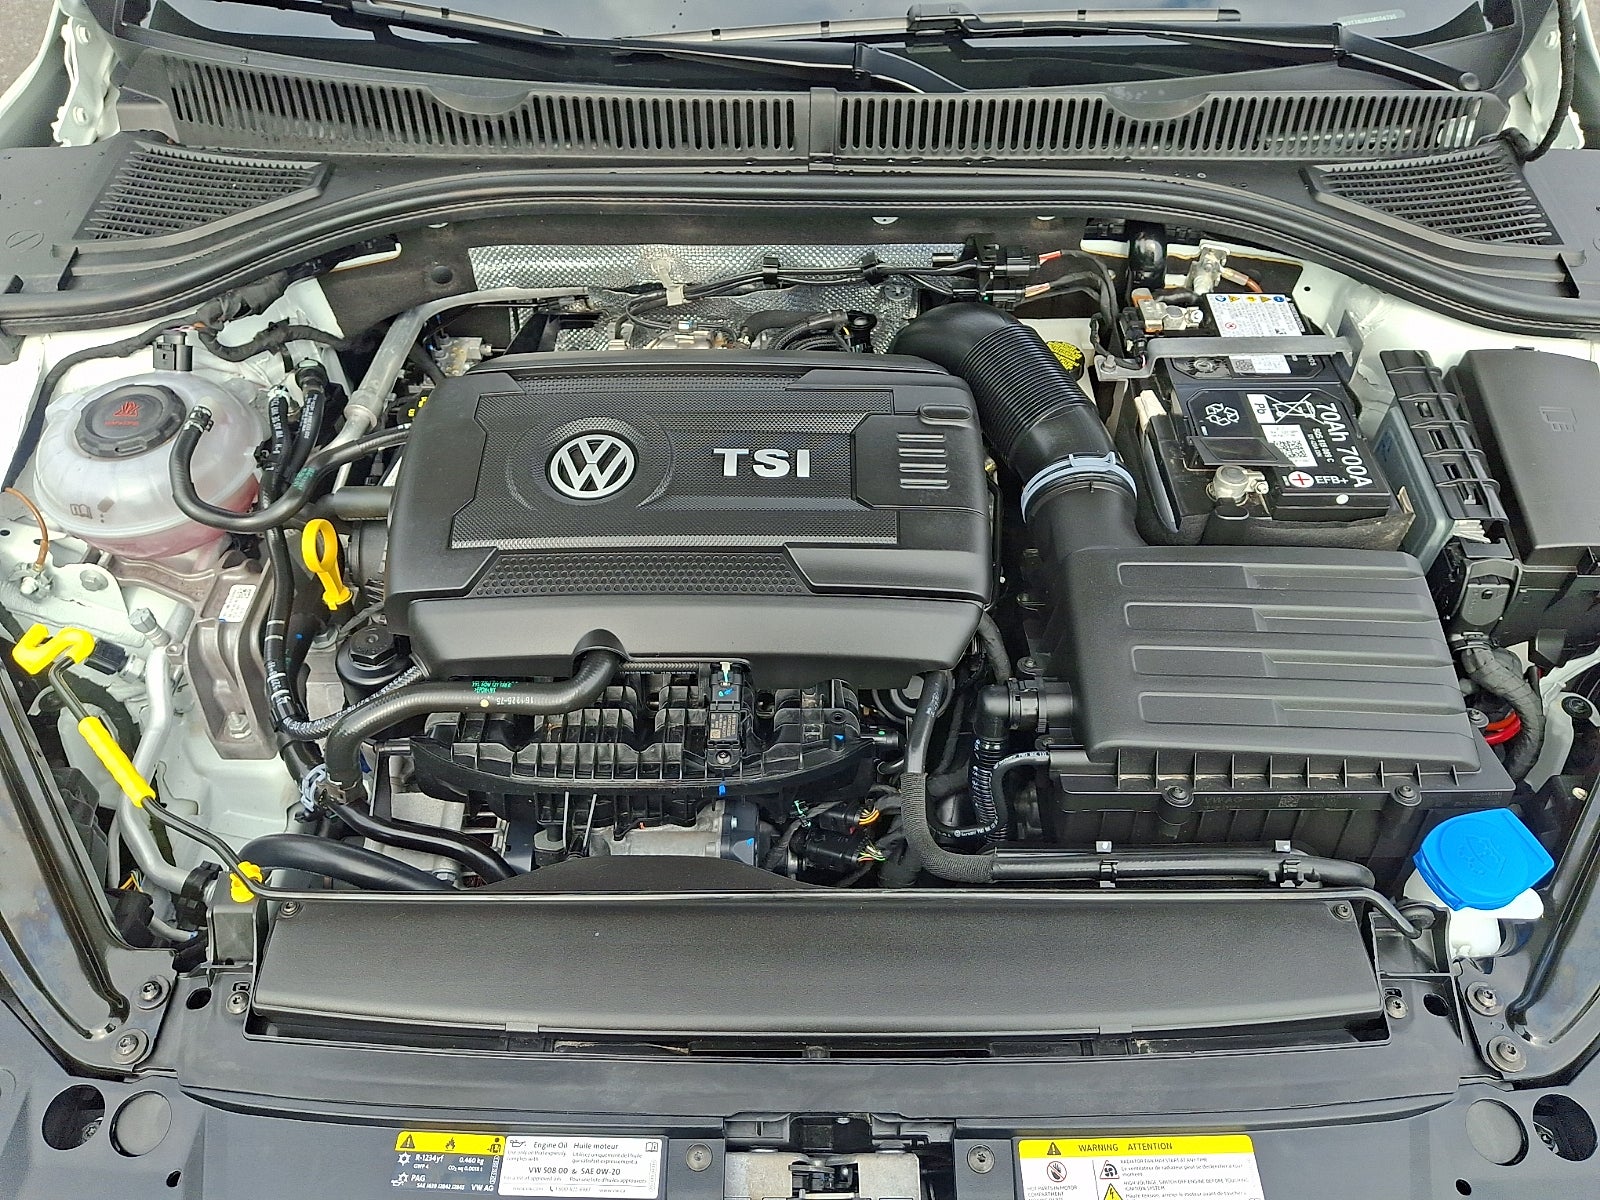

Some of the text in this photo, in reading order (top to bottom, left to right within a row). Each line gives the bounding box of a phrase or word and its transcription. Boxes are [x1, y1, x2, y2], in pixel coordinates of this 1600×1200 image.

[1254, 402, 1266, 415] Pb
[1315, 402, 1373, 488] 70Ah 700A
[549, 433, 636, 499] VW
[714, 448, 811, 478] TSI
[1314, 475, 1349, 484] EFB+
[533, 1141, 568, 1150] Engine Oil
[573, 1142, 592, 1150] Huile
[1078, 1142, 1173, 1152] WARNING ATTENTION
[414, 1153, 445, 1164] R-1234yf
[477, 1157, 485, 1166] kg
[528, 1166, 542, 1174] VW
[543, 1166, 557, 1174] 508
[580, 1167, 594, 1175] SAE
[595, 1168, 621, 1176] 0W-20
[410, 1174, 426, 1182] PAG
[471, 1183, 495, 1192] VW AG
